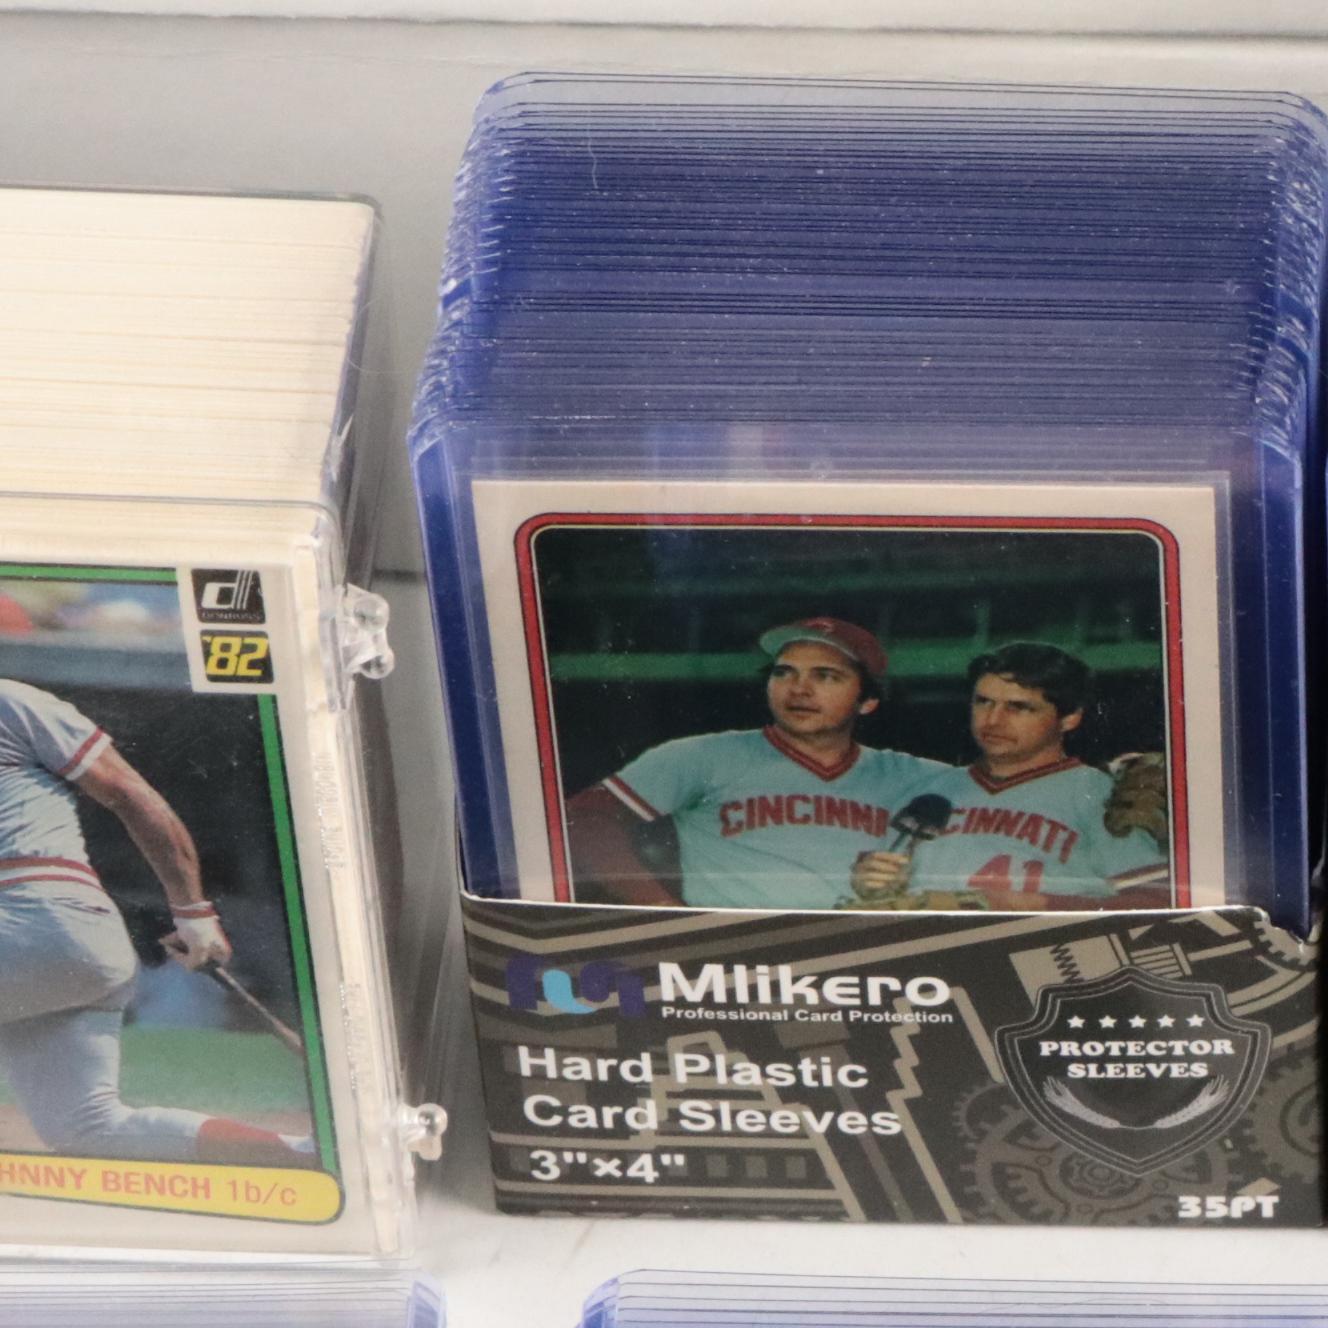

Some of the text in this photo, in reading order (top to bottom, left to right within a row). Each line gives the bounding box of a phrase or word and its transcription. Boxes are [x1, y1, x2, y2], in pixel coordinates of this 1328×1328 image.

[967, 854, 1045, 894] 41
[659, 962, 951, 1007] Mlikero
[661, 1005, 954, 1024] Professional Card Protection
[518, 1046, 868, 1088] Hard Plastic
[1039, 1039, 1235, 1057] PROTECTOR
[1067, 1062, 1209, 1079] SLEEVES
[524, 1094, 903, 1136] Card Sleeves
[101, 1169, 212, 1200] BENCH
[227, 1179, 298, 1207] 1b/c
[1178, 1194, 1279, 1219] 35PT
